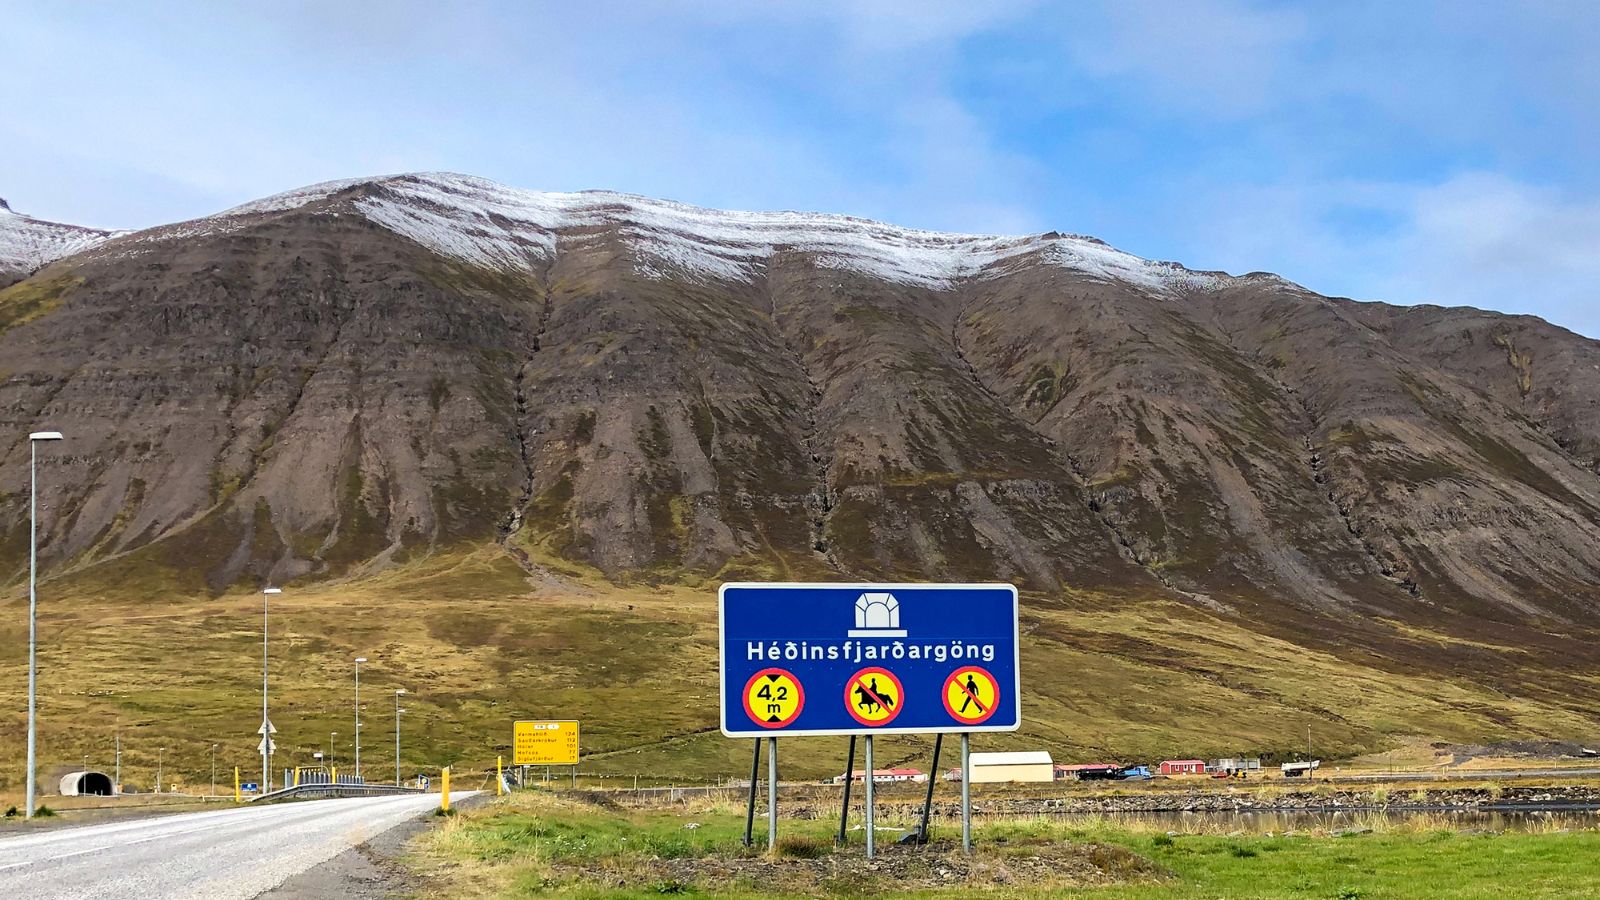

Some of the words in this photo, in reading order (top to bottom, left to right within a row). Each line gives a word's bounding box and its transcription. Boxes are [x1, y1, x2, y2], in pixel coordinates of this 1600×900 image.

[747, 640, 995, 663] Héðinsfjarðargöng
[757, 684, 787, 701] 4,2
[767, 703, 781, 714] m
